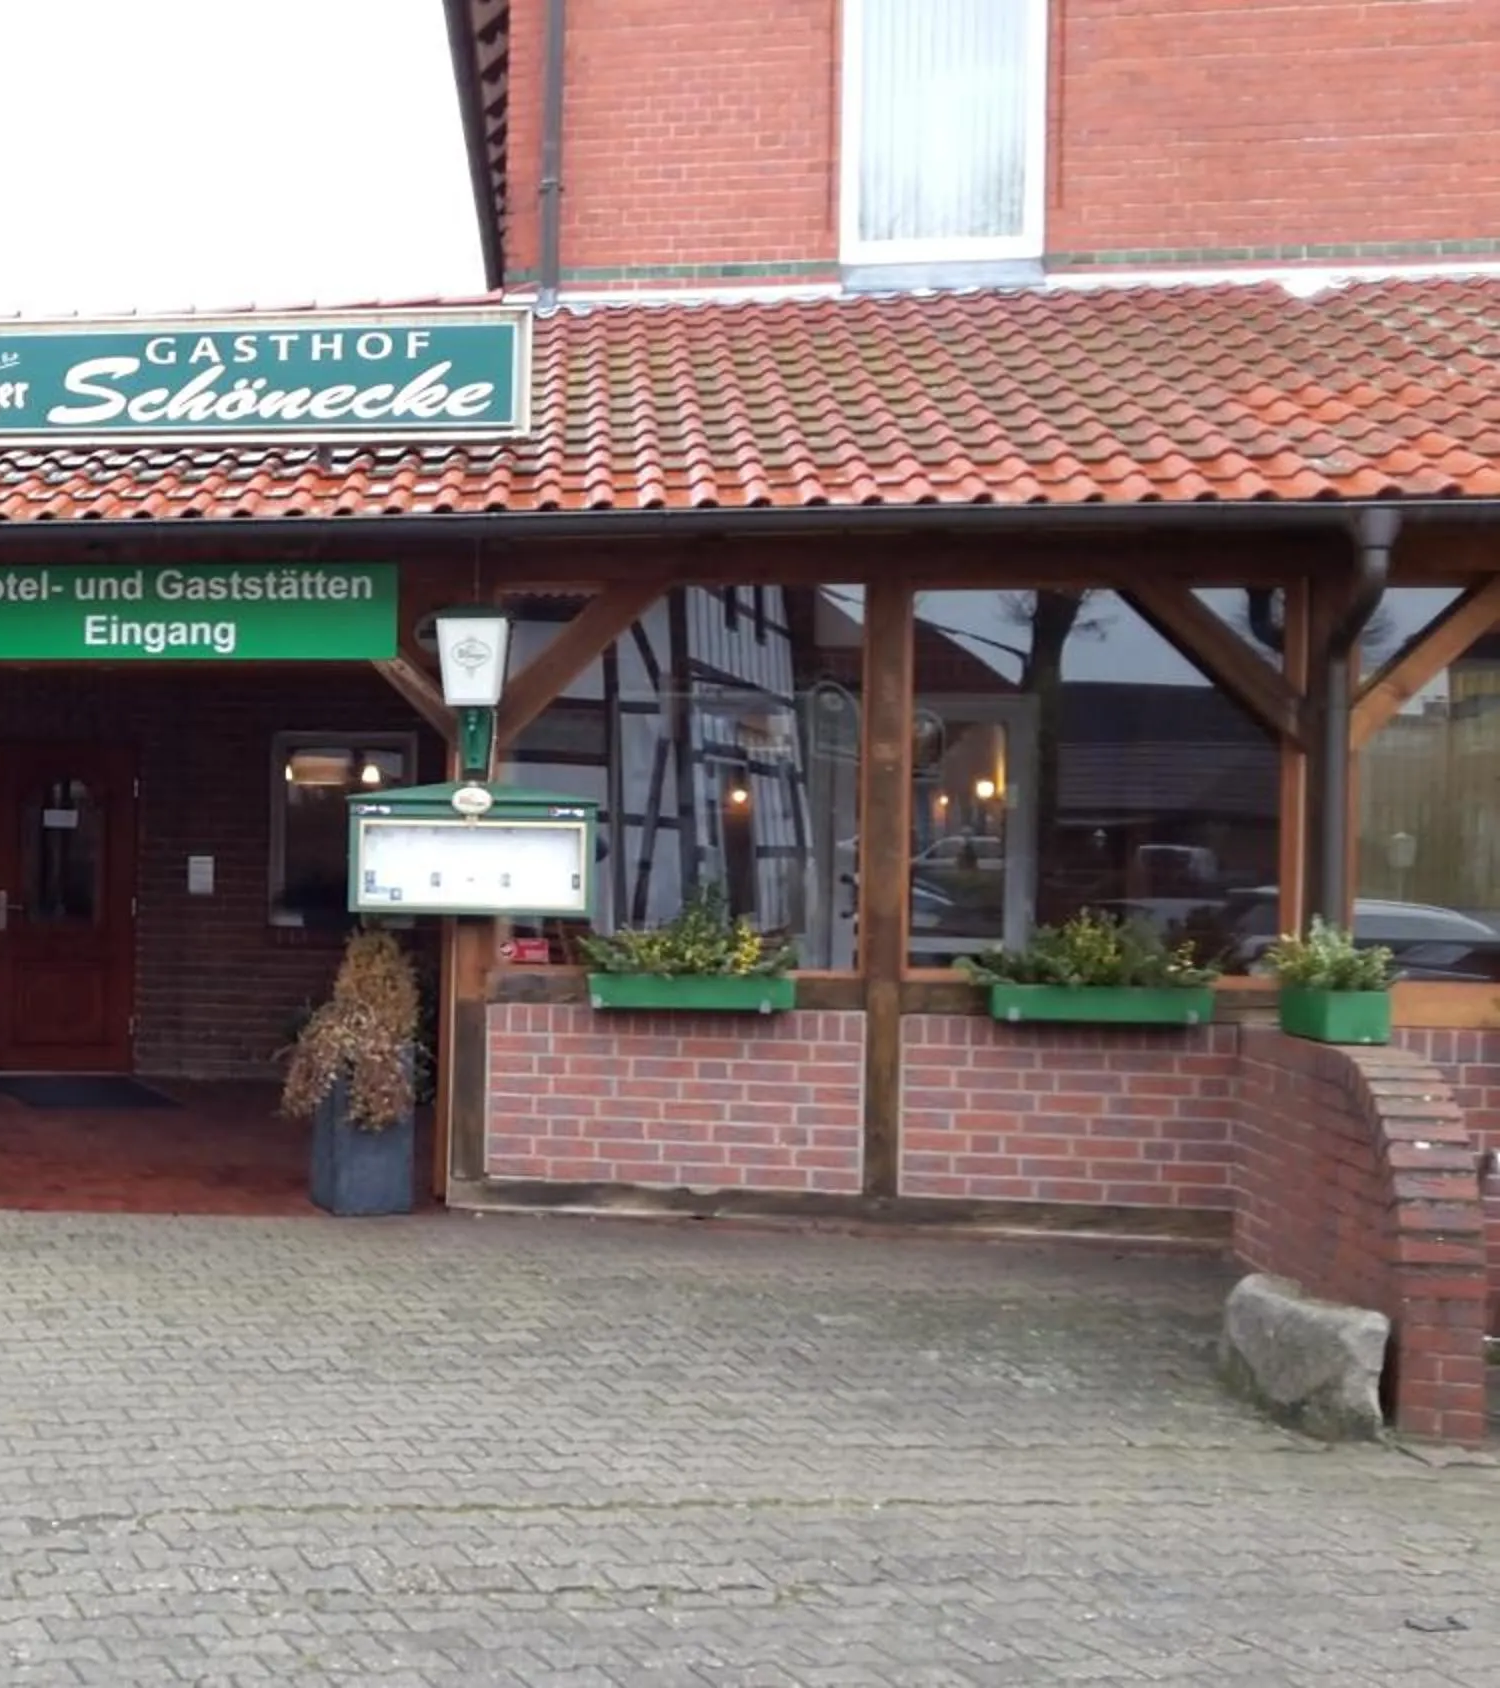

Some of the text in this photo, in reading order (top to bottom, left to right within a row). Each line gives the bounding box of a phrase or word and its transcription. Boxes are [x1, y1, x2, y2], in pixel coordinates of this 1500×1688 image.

[145, 331, 431, 364] GASTHOF
[46, 362, 496, 425] Schönecke
[75, 571, 143, 600] und
[156, 570, 372, 600] Gaststätten
[84, 614, 237, 654] Eingang
